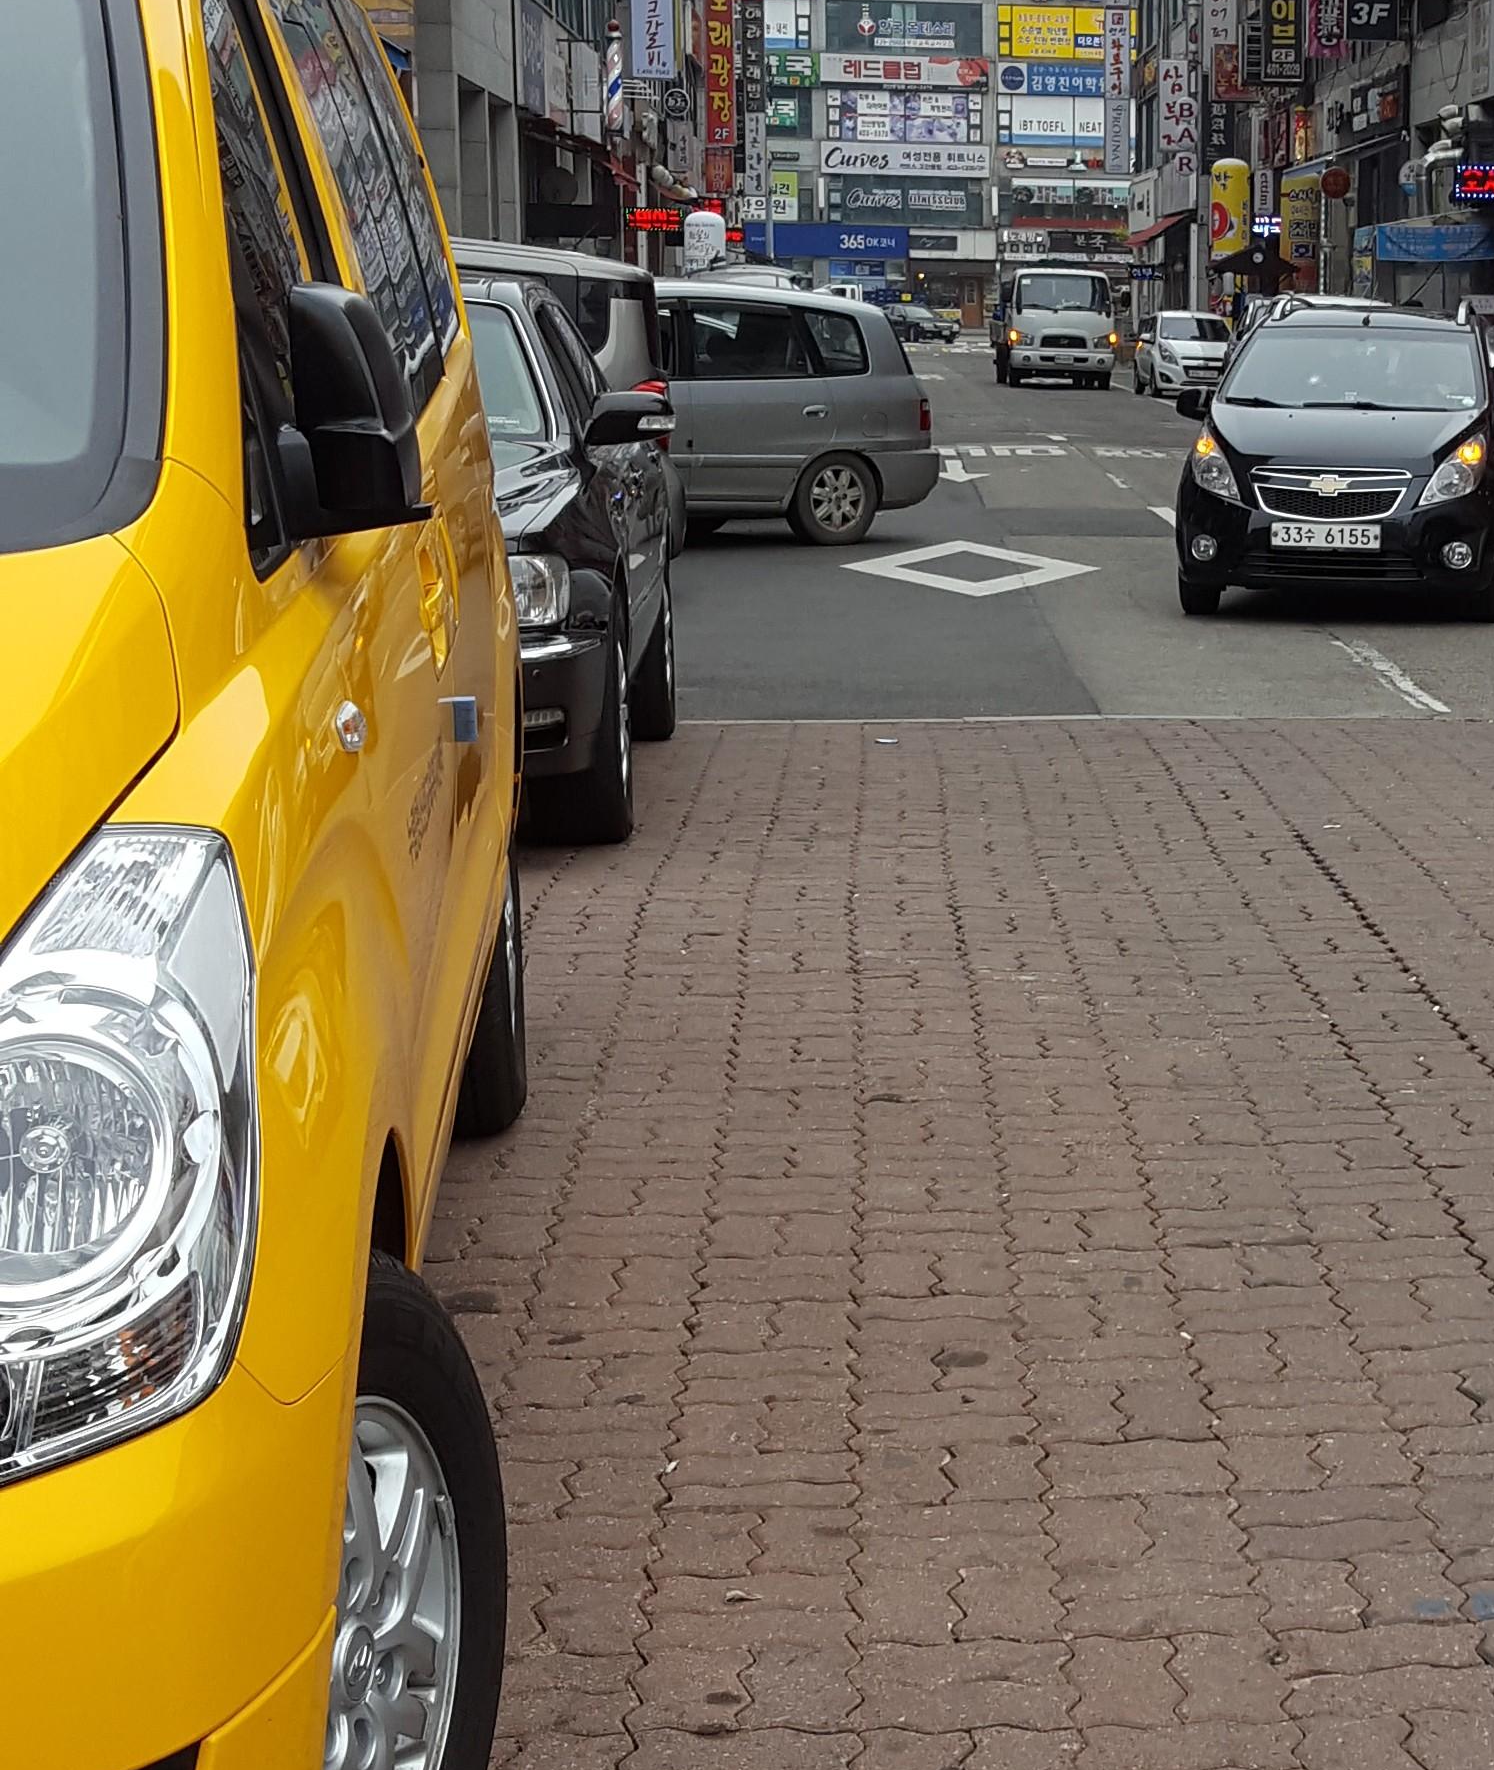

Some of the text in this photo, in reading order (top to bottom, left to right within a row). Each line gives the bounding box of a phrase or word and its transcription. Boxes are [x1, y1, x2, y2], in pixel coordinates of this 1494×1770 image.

[1350, 2, 1391, 26] 3F
[1273, 48, 1296, 61] 2F
[714, 127, 730, 140] 2F
[1037, 120, 1067, 133] TOEFL
[1079, 121, 1103, 134] NEAT
[824, 146, 890, 170] Curves
[901, 150, 942, 162] 여성전용
[846, 187, 902, 209] Curves
[838, 234, 865, 250] 365
[1281, 526, 1371, 546] 33수 6155
